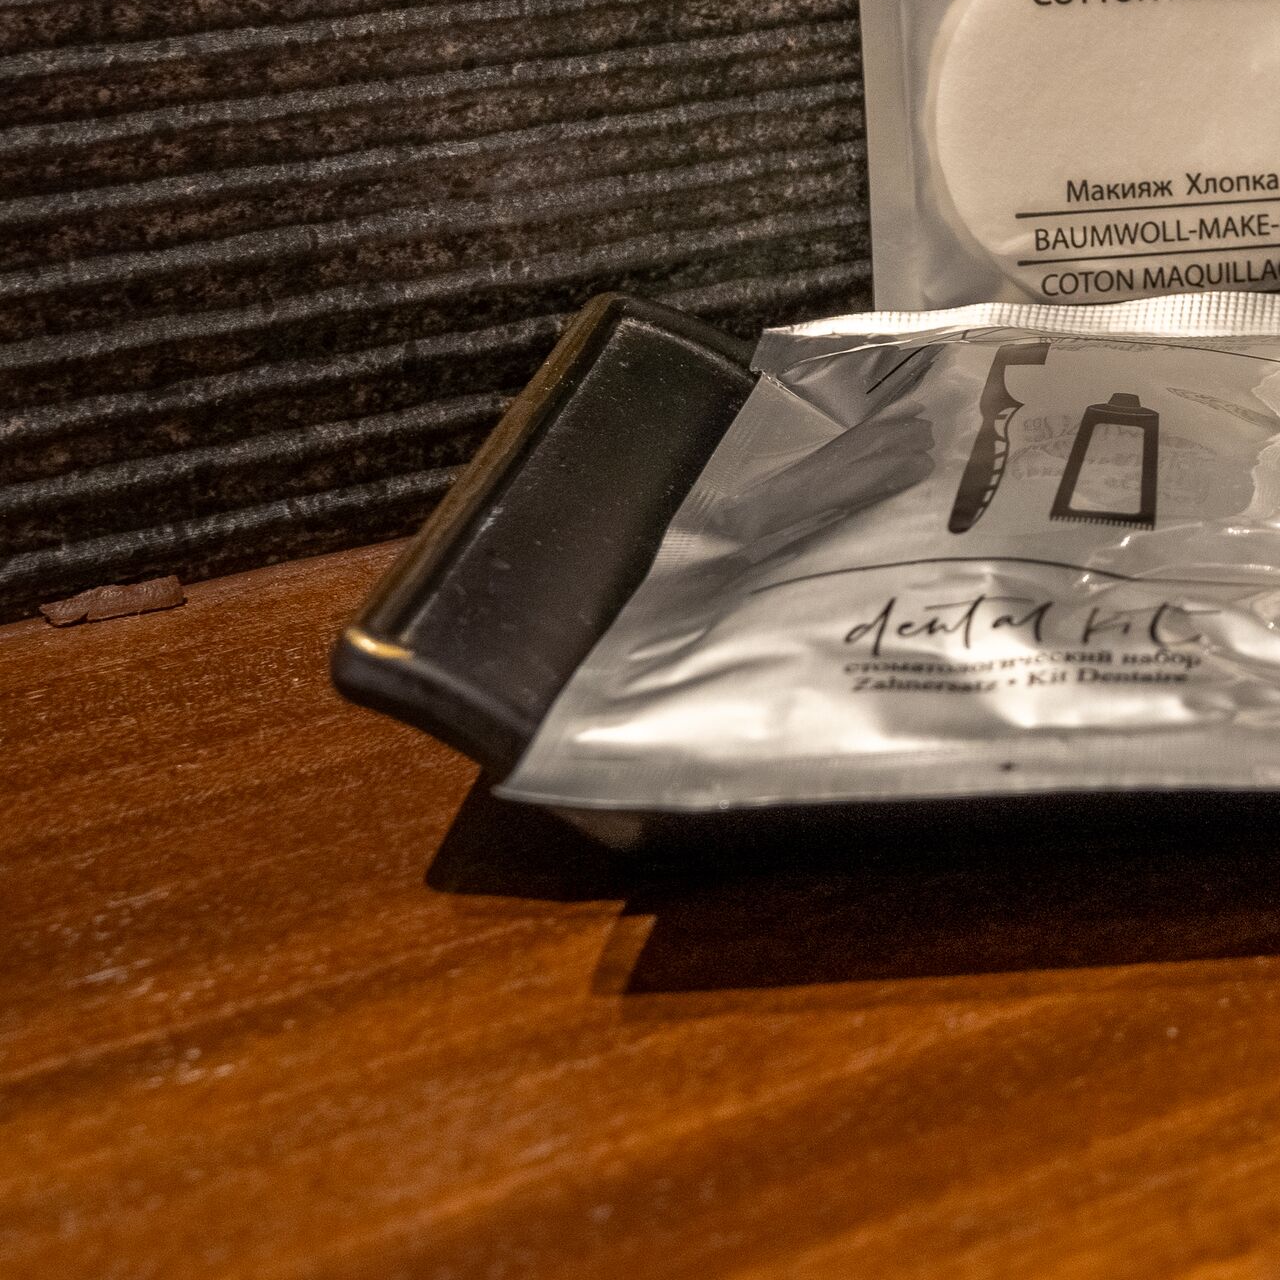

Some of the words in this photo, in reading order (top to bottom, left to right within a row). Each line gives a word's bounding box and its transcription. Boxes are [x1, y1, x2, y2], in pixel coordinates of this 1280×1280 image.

[1066, 177, 1174, 205] Макияж
[1185, 171, 1280, 199] Хлопка
[1041, 266, 1137, 298] COTON
[843, 593, 1054, 657] dental
